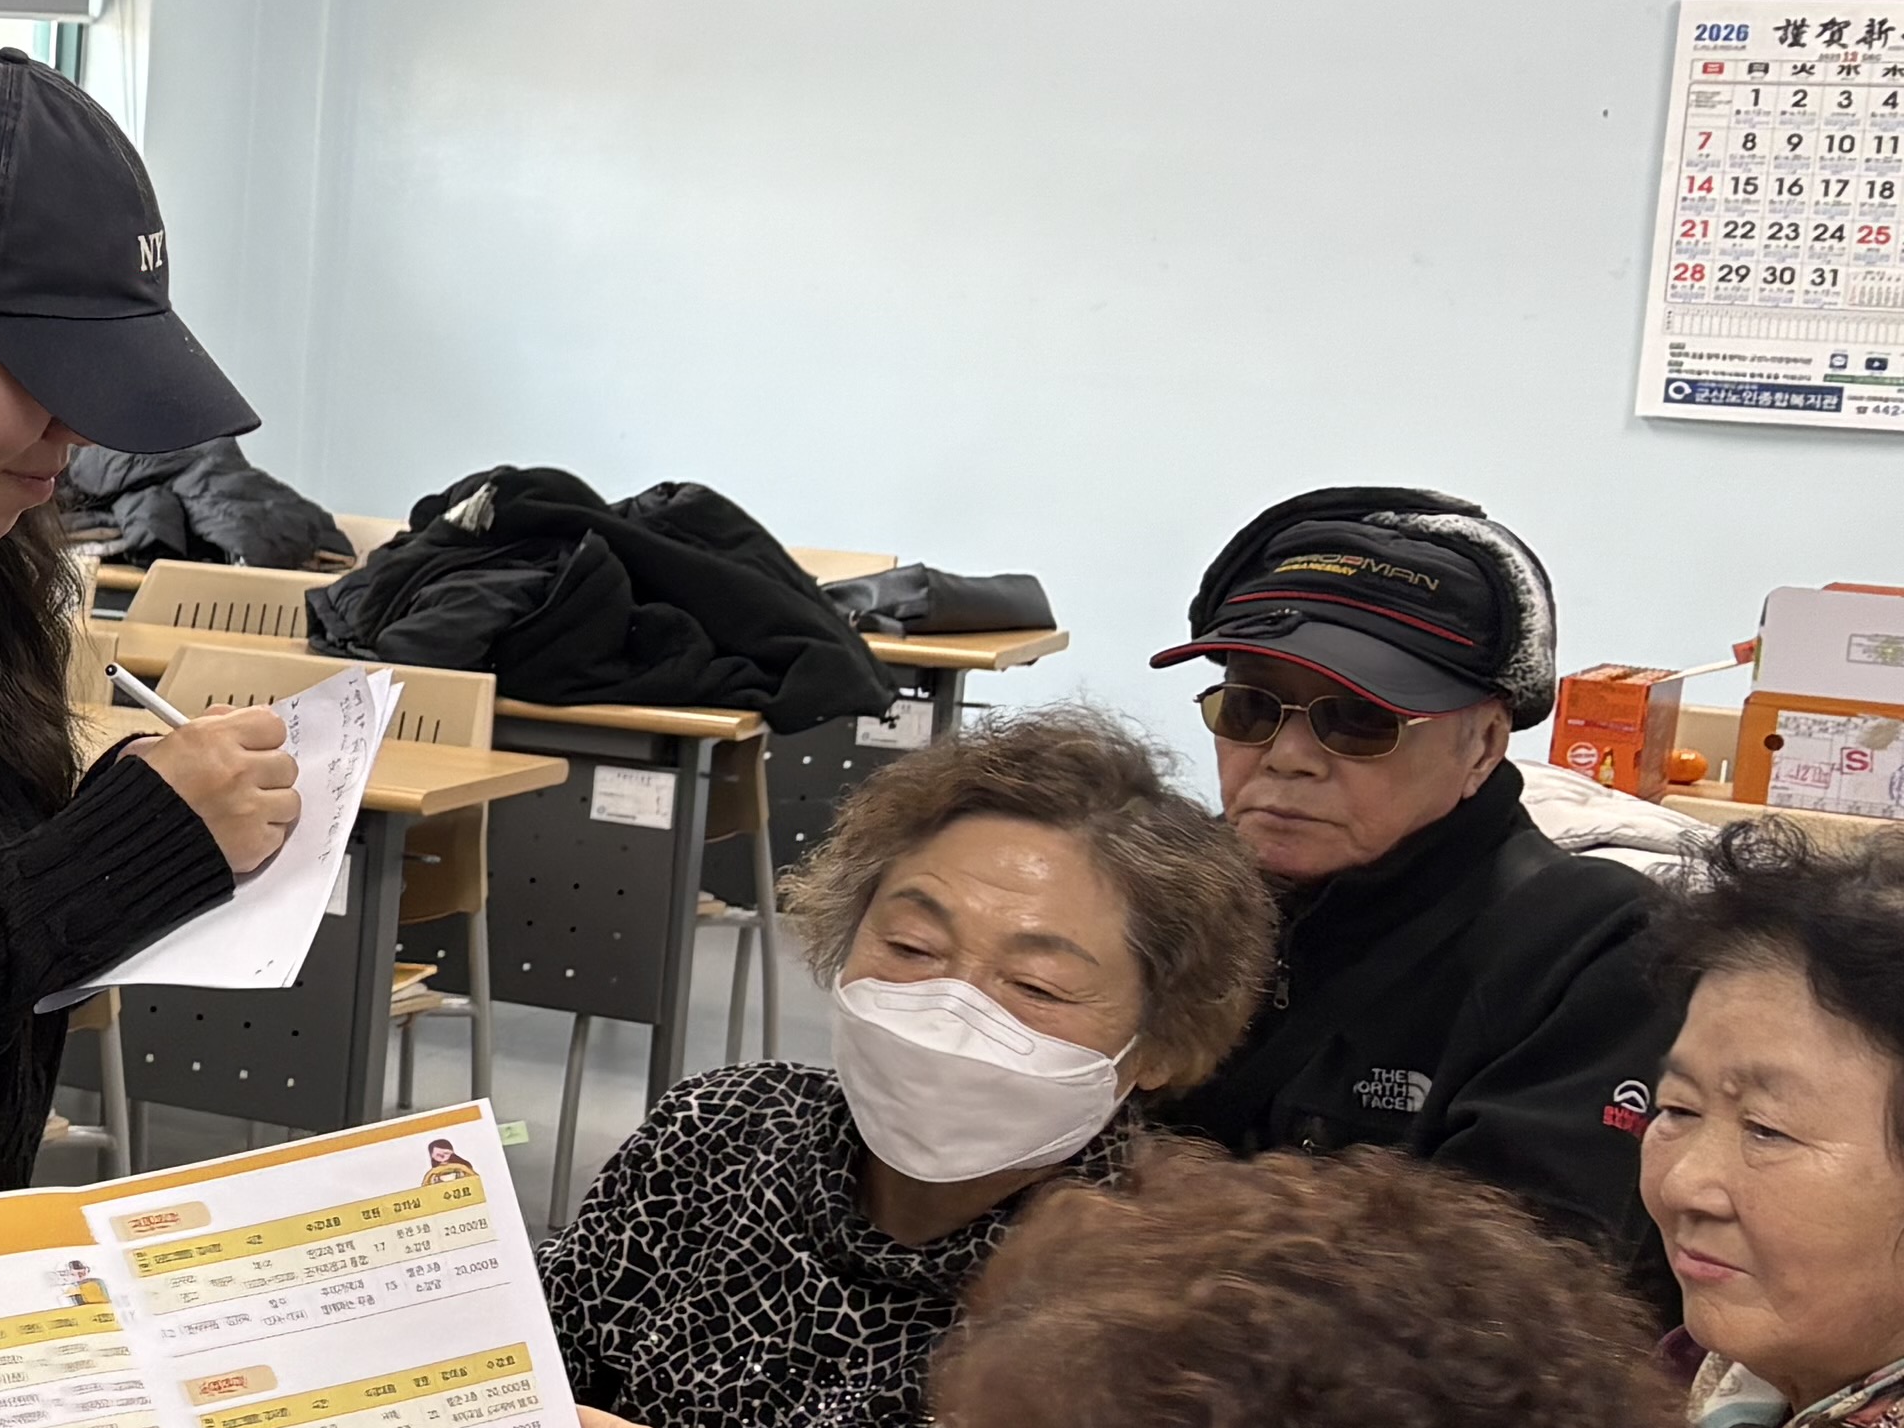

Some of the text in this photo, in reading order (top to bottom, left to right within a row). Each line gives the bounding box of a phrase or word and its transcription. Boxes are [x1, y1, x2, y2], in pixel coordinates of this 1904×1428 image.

[1694, 23, 1750, 42] 2026
[1773, 17, 1904, 50] 謹賀新
[1750, 88, 1761, 107] 1
[1792, 89, 1809, 108] 2
[1836, 90, 1853, 109] 3
[1882, 90, 1900, 110] 4
[1698, 131, 1900, 154] 7 8 9 10 11
[1686, 175, 1895, 199] 14 15 16 17 18
[1680, 219, 1892, 245] 21 22 23 24 25
[137, 229, 164, 272] NY
[1673, 263, 1839, 288] 28 29 30 31
[1694, 386, 1839, 410] 군산노인종합복지관
[1845, 749, 1870, 771] S
[1372, 1068, 1407, 1083] THE
